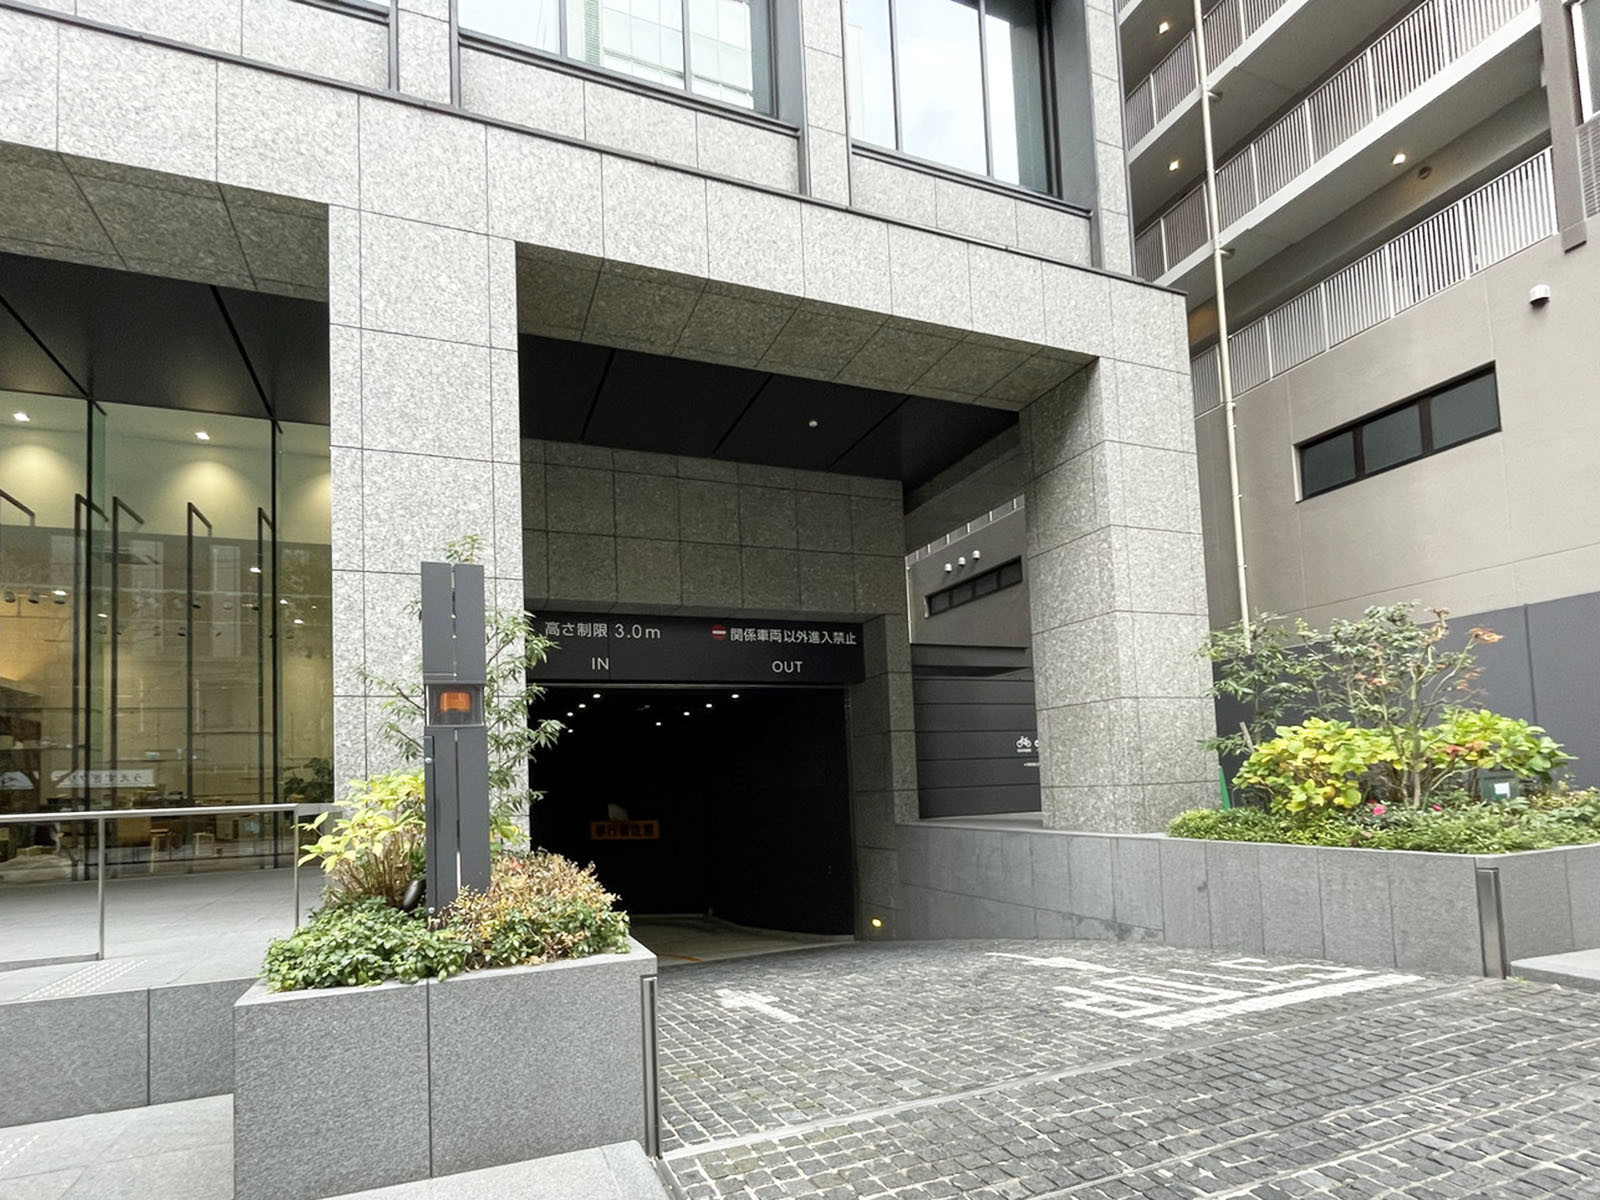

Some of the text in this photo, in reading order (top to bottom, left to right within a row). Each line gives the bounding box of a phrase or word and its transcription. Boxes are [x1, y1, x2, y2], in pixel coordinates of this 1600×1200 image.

[544, 621, 661, 639] 高さ制限 3.0m
[730, 627, 857, 645] 関係車両以外進入禁止
[591, 657, 610, 671] IN
[772, 660, 803, 674] OUT
